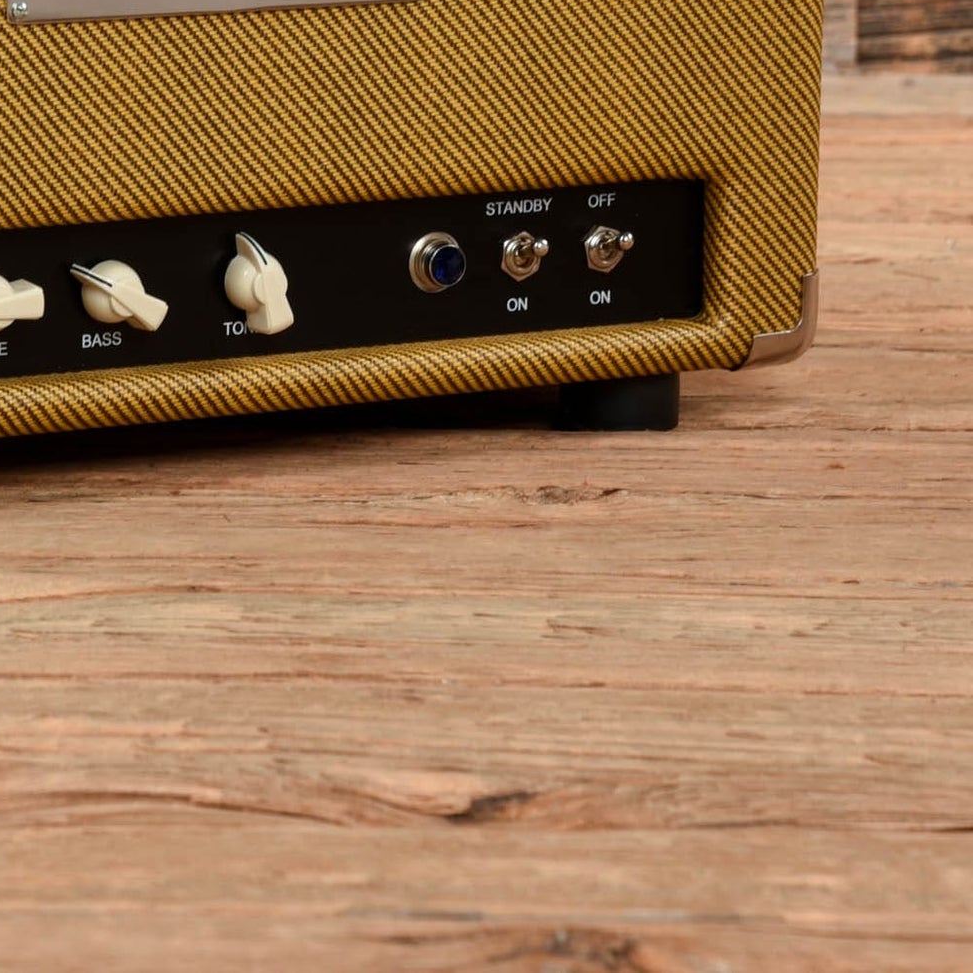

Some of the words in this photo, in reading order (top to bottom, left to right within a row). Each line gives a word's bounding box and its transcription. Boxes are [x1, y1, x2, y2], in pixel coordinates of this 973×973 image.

[485, 197, 553, 216] STANDBY
[587, 193, 616, 208] OFF
[506, 297, 529, 312] ON
[589, 290, 612, 306] ON
[223, 321, 260, 336] TO
[81, 331, 122, 349] BASS
